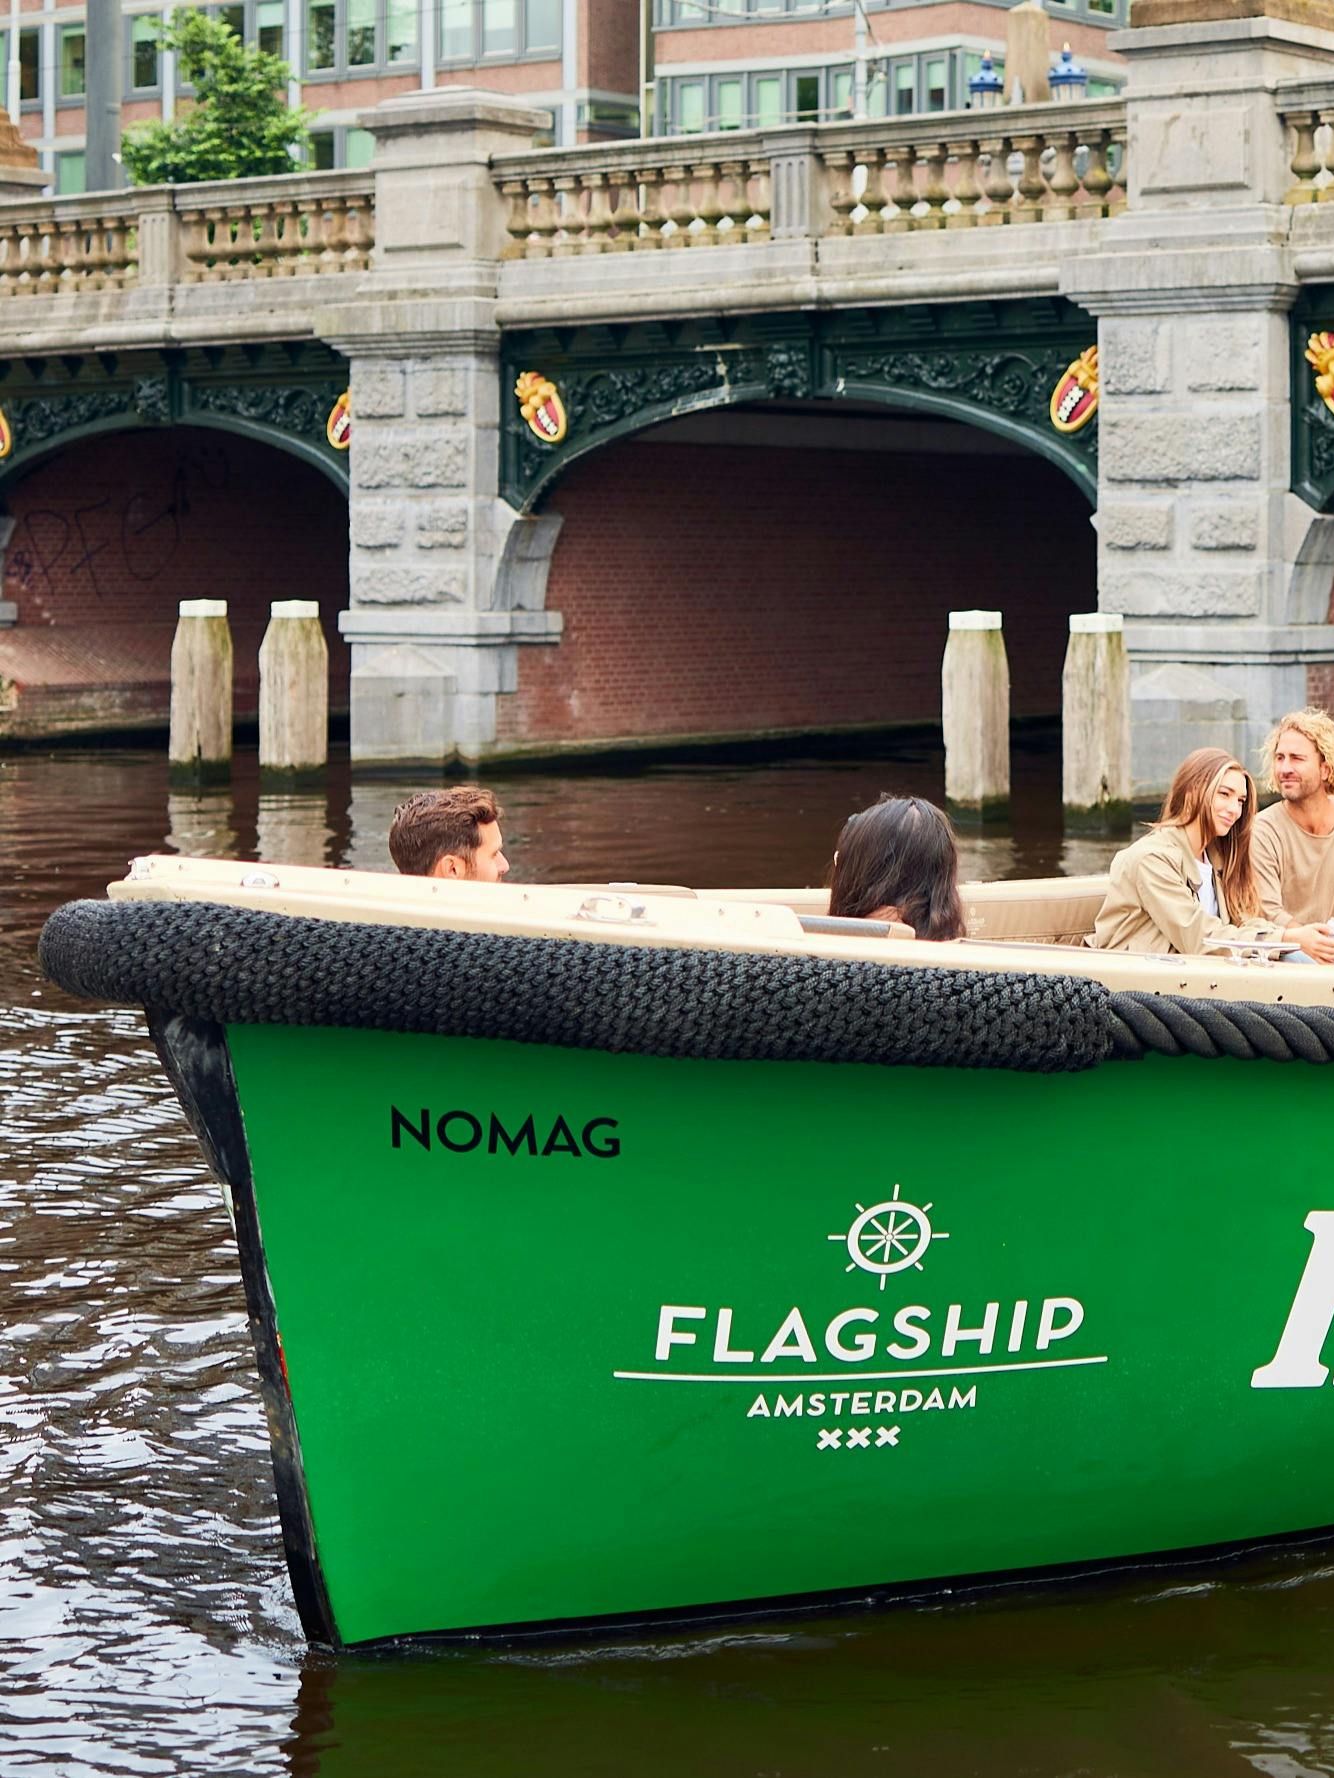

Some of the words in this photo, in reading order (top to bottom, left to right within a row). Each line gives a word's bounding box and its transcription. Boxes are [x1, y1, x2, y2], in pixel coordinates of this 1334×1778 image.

[390, 1104, 621, 1159] NOMAG
[655, 1297, 1085, 1363] FLAGSHIP
[746, 1385, 977, 1418] AMSTERDAM
